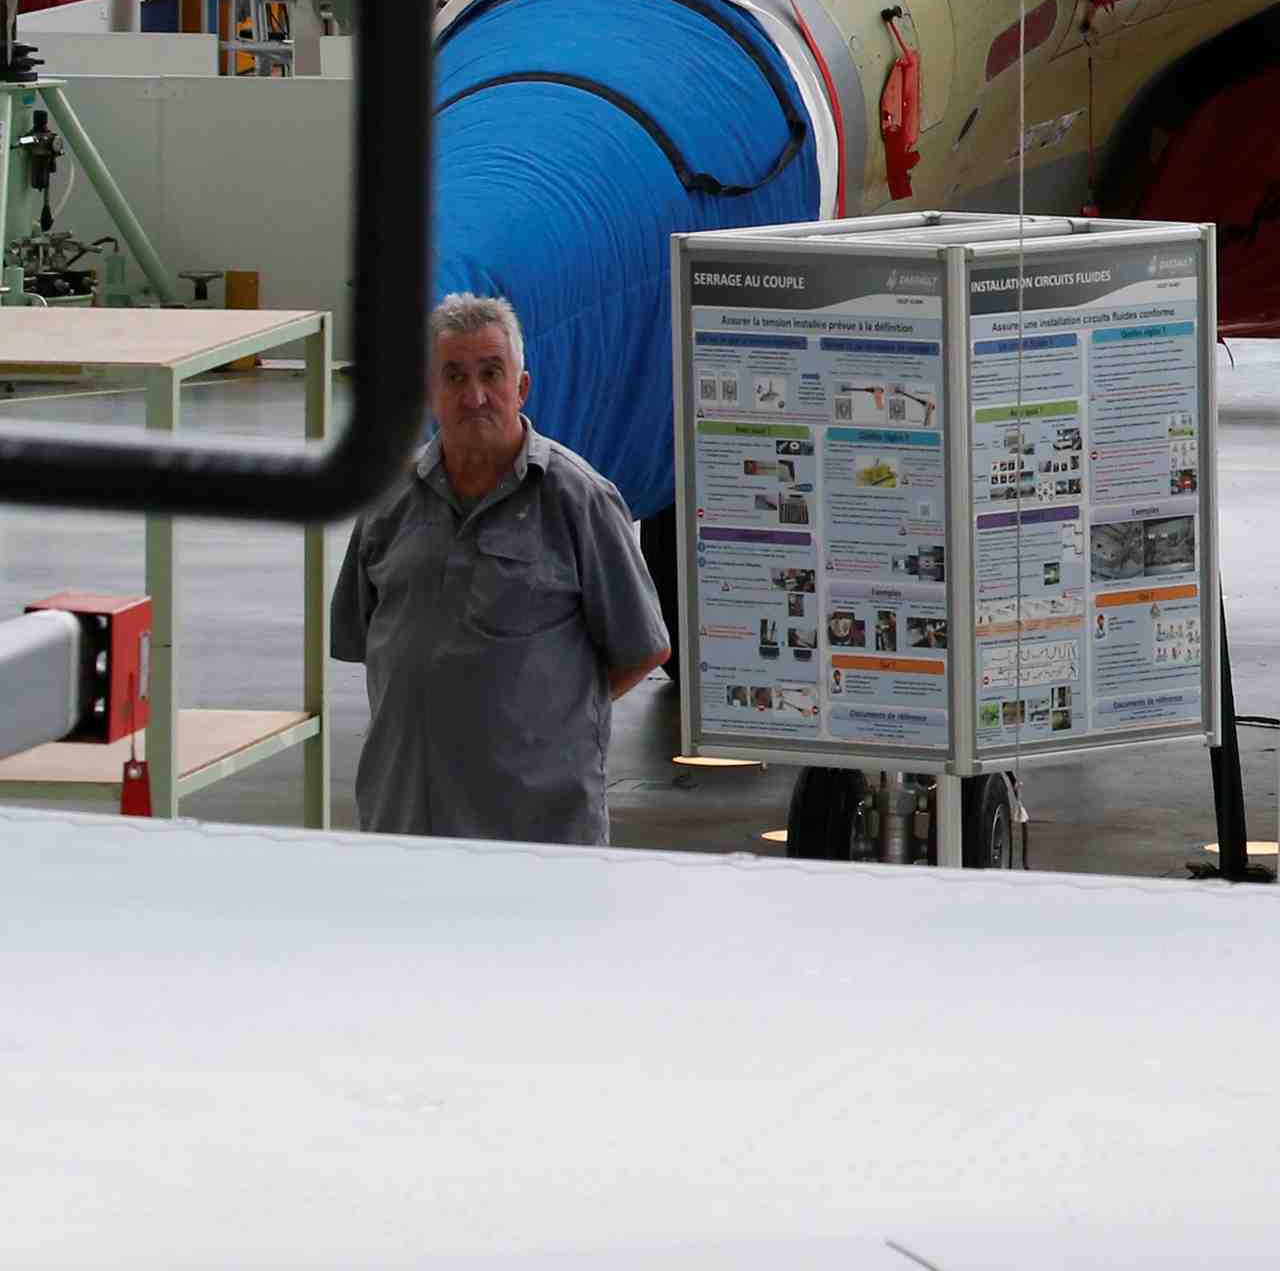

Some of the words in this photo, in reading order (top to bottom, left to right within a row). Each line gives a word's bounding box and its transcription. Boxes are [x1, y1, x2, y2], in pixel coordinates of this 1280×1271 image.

[694, 272, 742, 287] SERRAGE
[744, 275, 761, 287] AU
[762, 276, 805, 289] COUPLE
[971, 275, 1033, 292] INSTALLATION
[1035, 273, 1074, 287] CIRCUITS
[1076, 270, 1111, 285] FLUIDES
[762, 317, 792, 328] tension
[992, 320, 1021, 333] Assure
